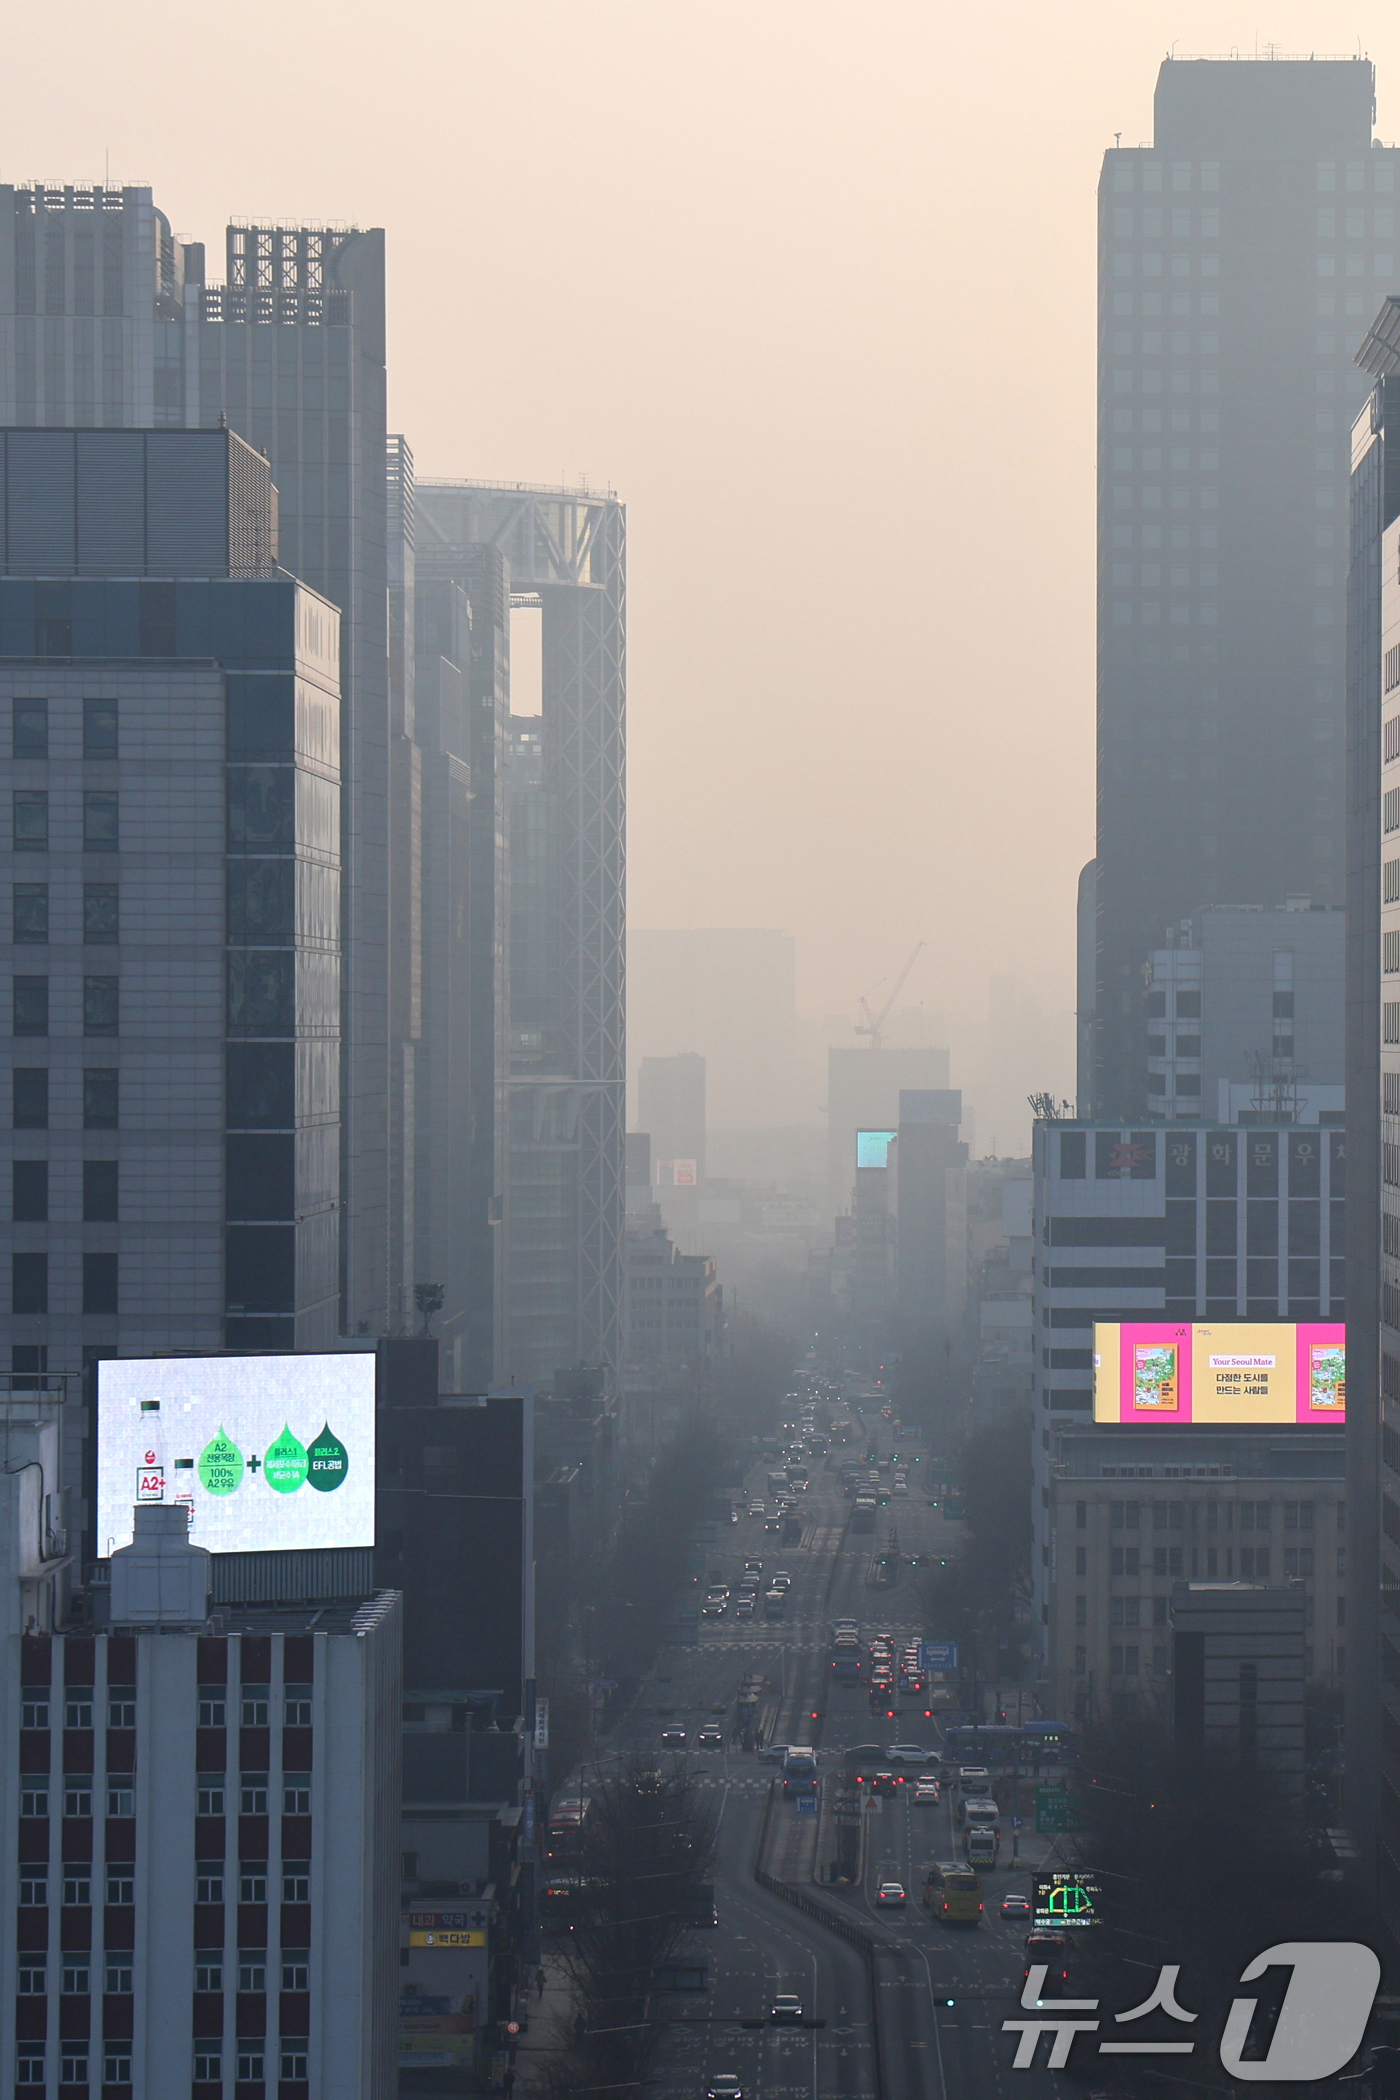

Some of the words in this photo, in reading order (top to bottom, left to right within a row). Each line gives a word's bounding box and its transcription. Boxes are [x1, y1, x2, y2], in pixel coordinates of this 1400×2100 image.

[1213, 1358, 1230, 1366] Your
[1231, 1358, 1252, 1366] Seoul
[1253, 1358, 1273, 1366] Mate
[1216, 1373, 1242, 1382] 다정한
[1243, 1373, 1269, 1382] 도시를
[1216, 1386, 1242, 1395] 만드는
[1243, 1386, 1269, 1395] 사람들
[214, 1443, 227, 1452] A2
[274, 1448, 298, 1456] 플러스1
[314, 1447, 340, 1455] 플러스2
[207, 1453, 235, 1463] 전용목장
[312, 1460, 342, 1470] EFL공법
[210, 1468, 234, 1478] 100%
[412, 1914, 435, 1927] 내과
[442, 1914, 465, 1927] 약국
